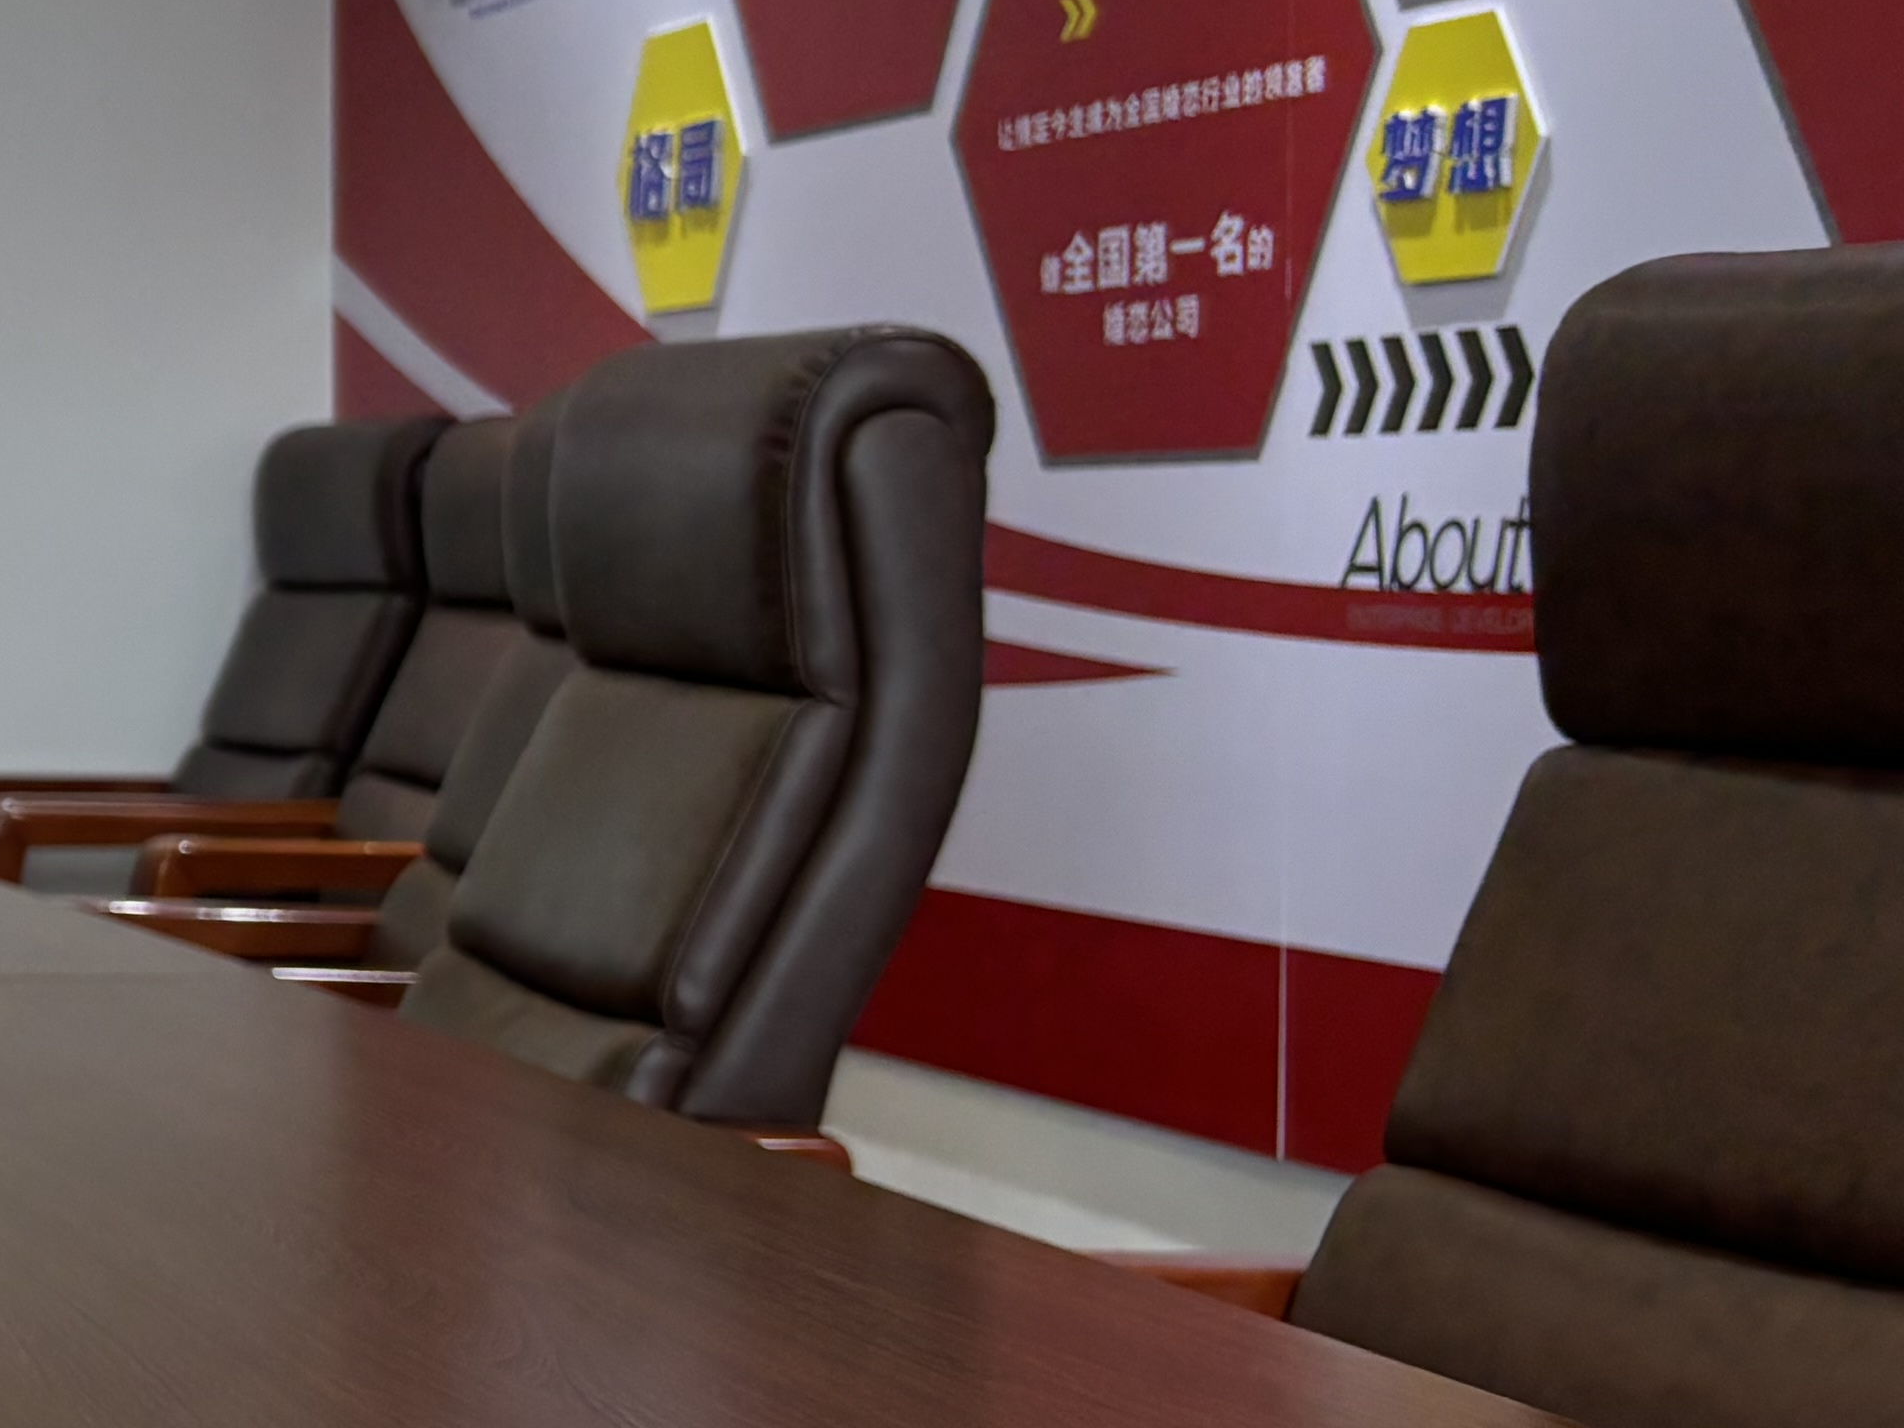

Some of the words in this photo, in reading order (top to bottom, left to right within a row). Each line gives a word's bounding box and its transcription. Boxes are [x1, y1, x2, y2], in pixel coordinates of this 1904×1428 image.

[628, 119, 720, 220] 格局
[1379, 93, 1518, 203] 梦想
[1340, 492, 1532, 593] About
